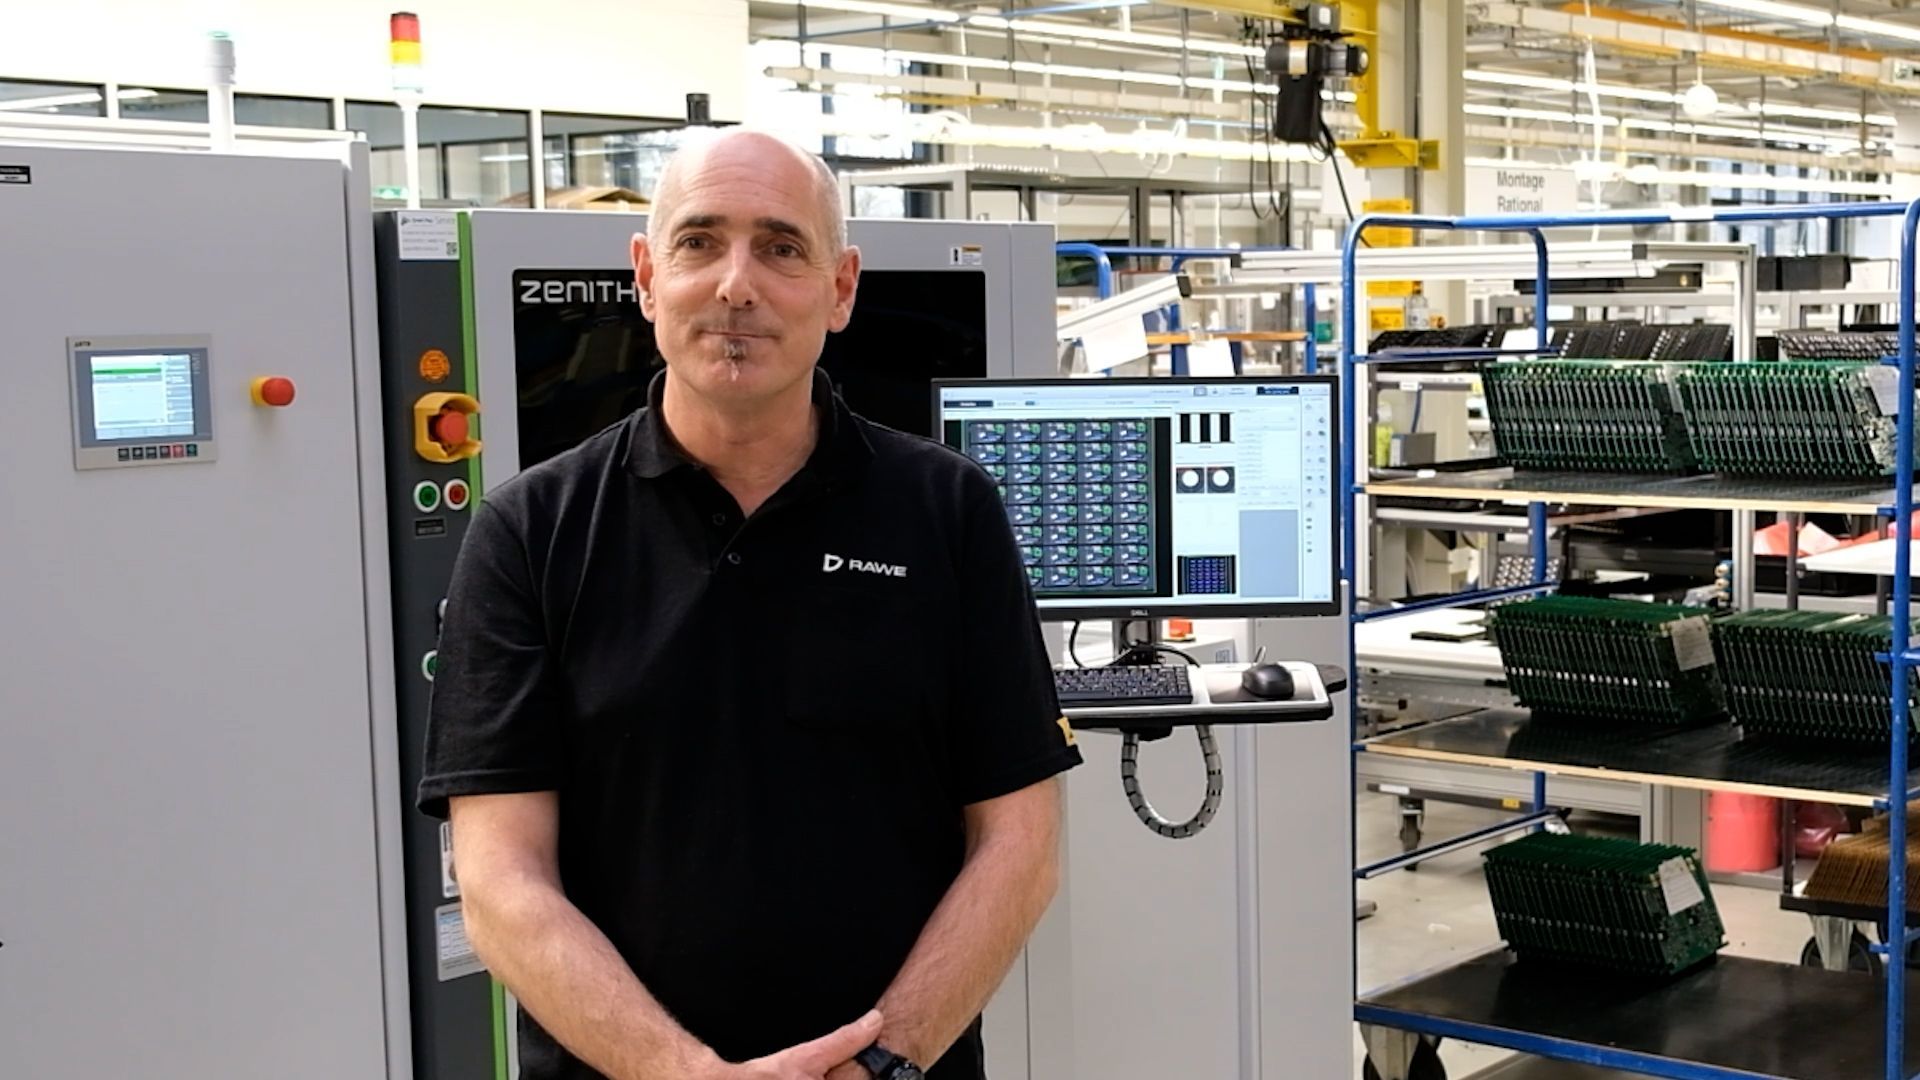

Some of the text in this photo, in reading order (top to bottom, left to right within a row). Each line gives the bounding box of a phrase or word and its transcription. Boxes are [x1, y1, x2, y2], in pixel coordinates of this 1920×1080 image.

[1496, 170, 1545, 192] Montage
[1496, 196, 1544, 212] Rational
[848, 558, 908, 577] RAWE
